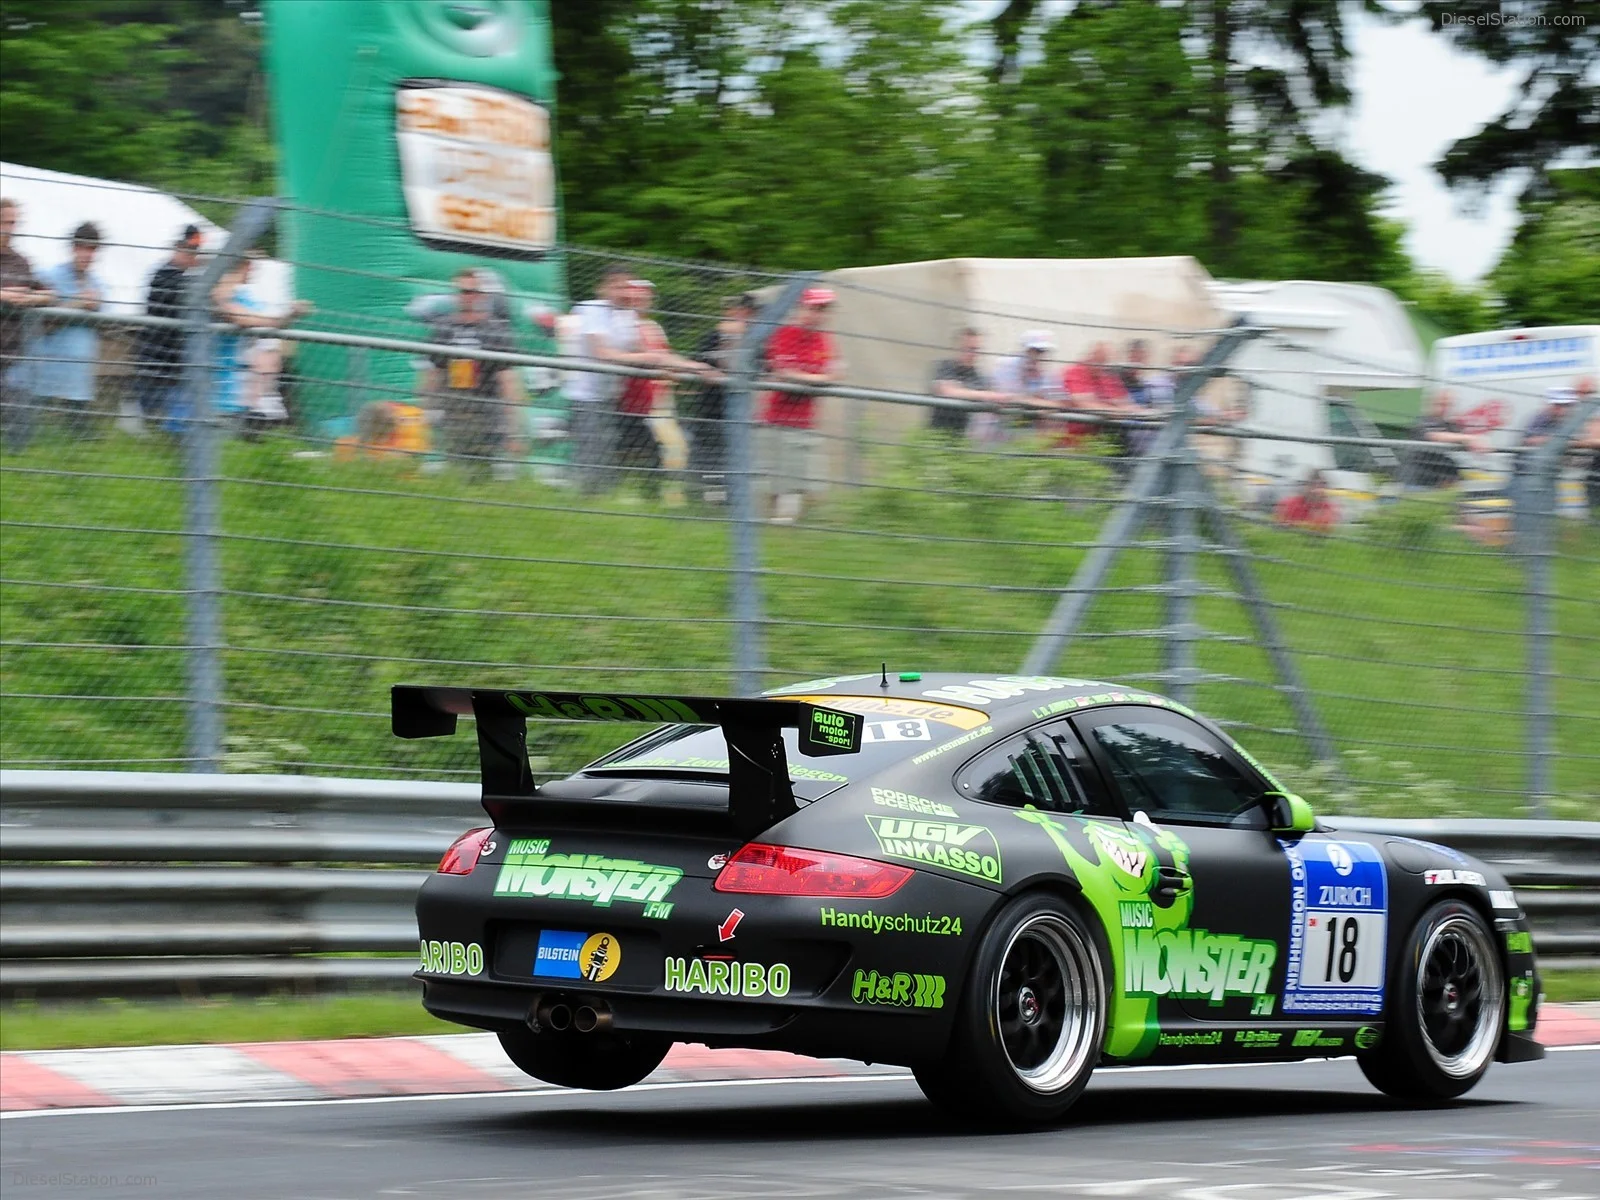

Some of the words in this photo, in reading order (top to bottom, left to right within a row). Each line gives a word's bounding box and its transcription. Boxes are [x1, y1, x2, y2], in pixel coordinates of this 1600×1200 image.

[814, 712, 845, 728] auto
[819, 725, 849, 737] motor
[867, 721, 922, 740] 18
[870, 787, 954, 812] PORSCHE
[878, 818, 985, 846] UGV
[508, 840, 550, 855] MUSIC
[883, 838, 998, 878] INKASSO
[498, 855, 681, 902] MONSTER
[1319, 886, 1372, 906] ZURICH
[643, 903, 672, 919] .FM
[820, 907, 963, 936] Handyschutz24
[1120, 902, 1153, 927] MUSIC
[418, 939, 484, 976] ARIBO
[538, 946, 579, 962] BILSTEIN
[1324, 917, 1359, 983] 18
[664, 957, 791, 997] HARIBO
[1125, 929, 1277, 1000] MONSTER
[852, 970, 914, 1006] H&R
